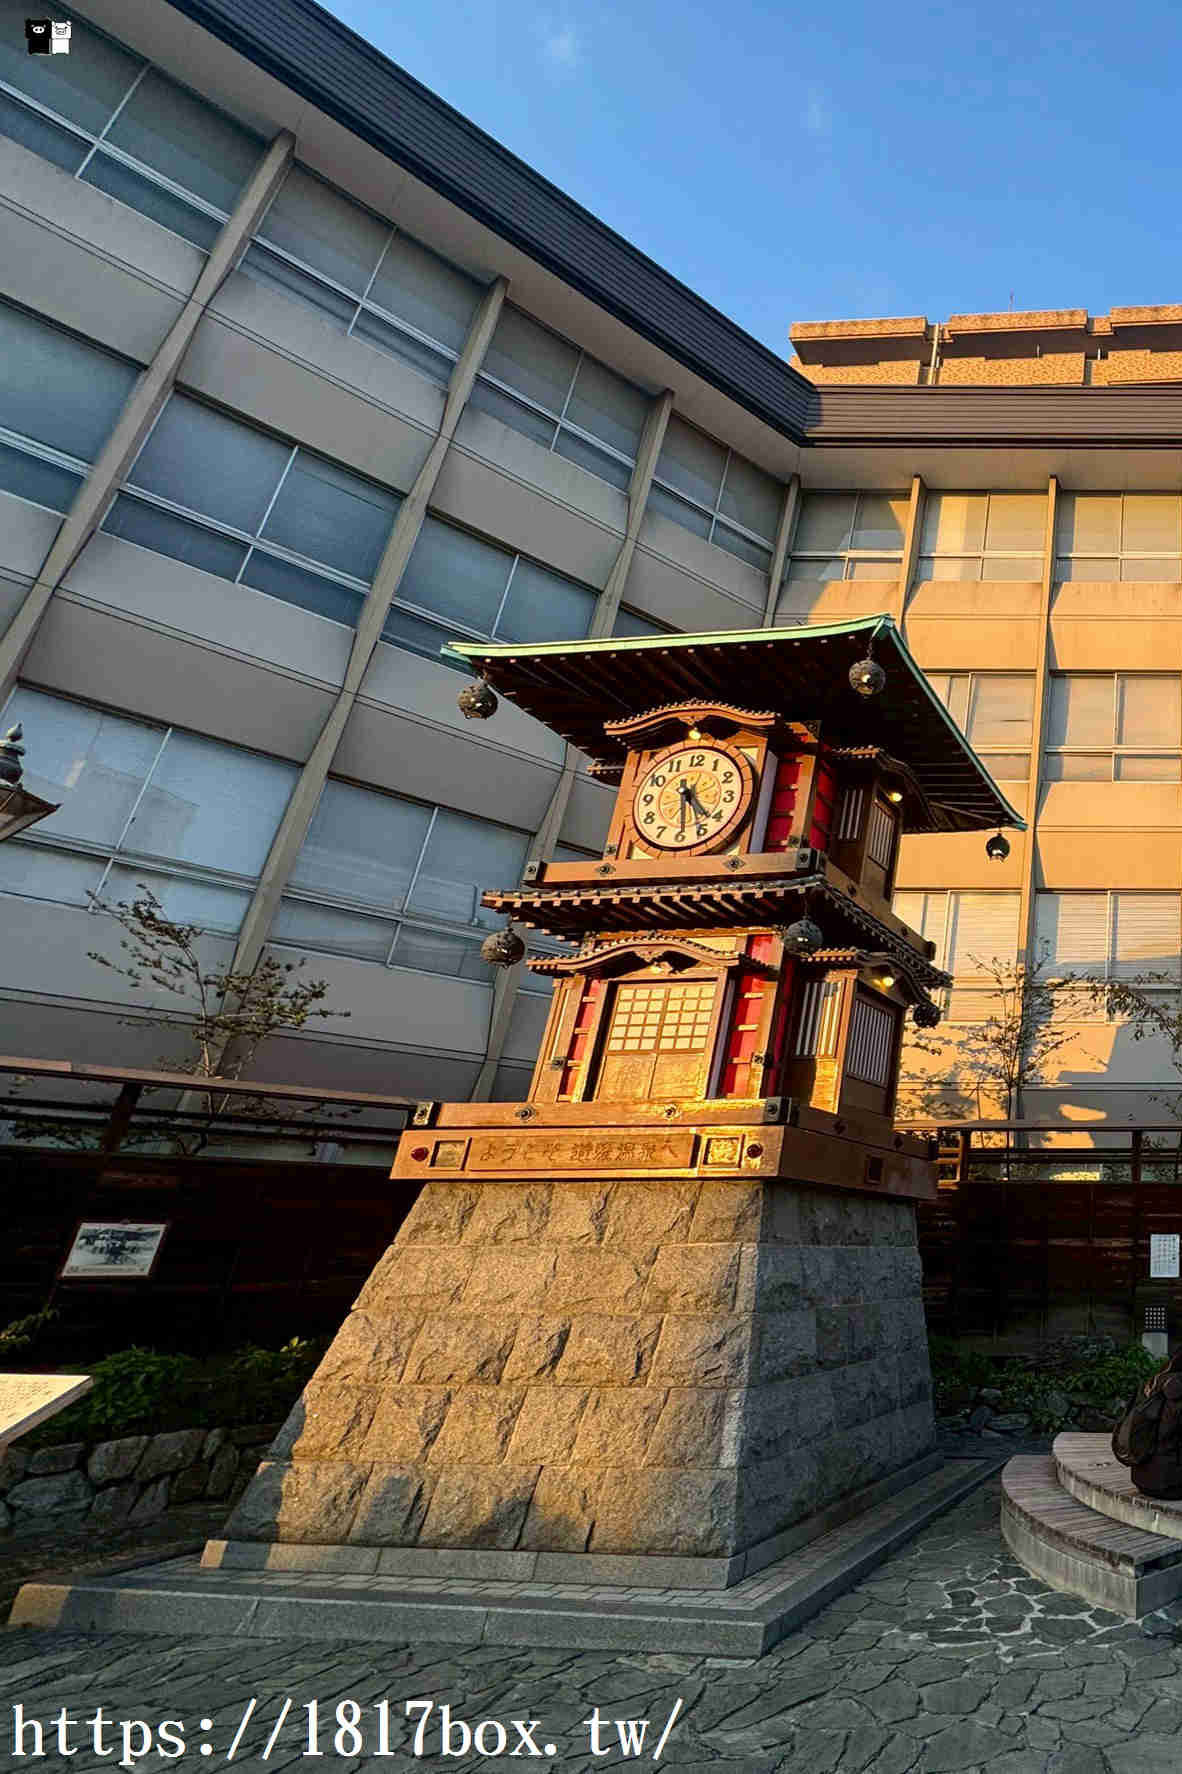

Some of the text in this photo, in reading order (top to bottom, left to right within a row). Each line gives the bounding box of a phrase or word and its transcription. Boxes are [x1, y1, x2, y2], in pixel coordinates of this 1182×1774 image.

[668, 759, 681, 772] 11
[689, 754, 705, 767] 12
[712, 759, 720, 771] 1
[650, 773, 666, 787] 10
[721, 771, 733, 784] 2
[643, 793, 654, 806] 9
[723, 790, 734, 803] 3
[643, 811, 655, 824] 8
[712, 808, 723, 822] 4
[656, 825, 667, 839] 7
[674, 830, 685, 842] 6
[696, 823, 708, 836] 5
